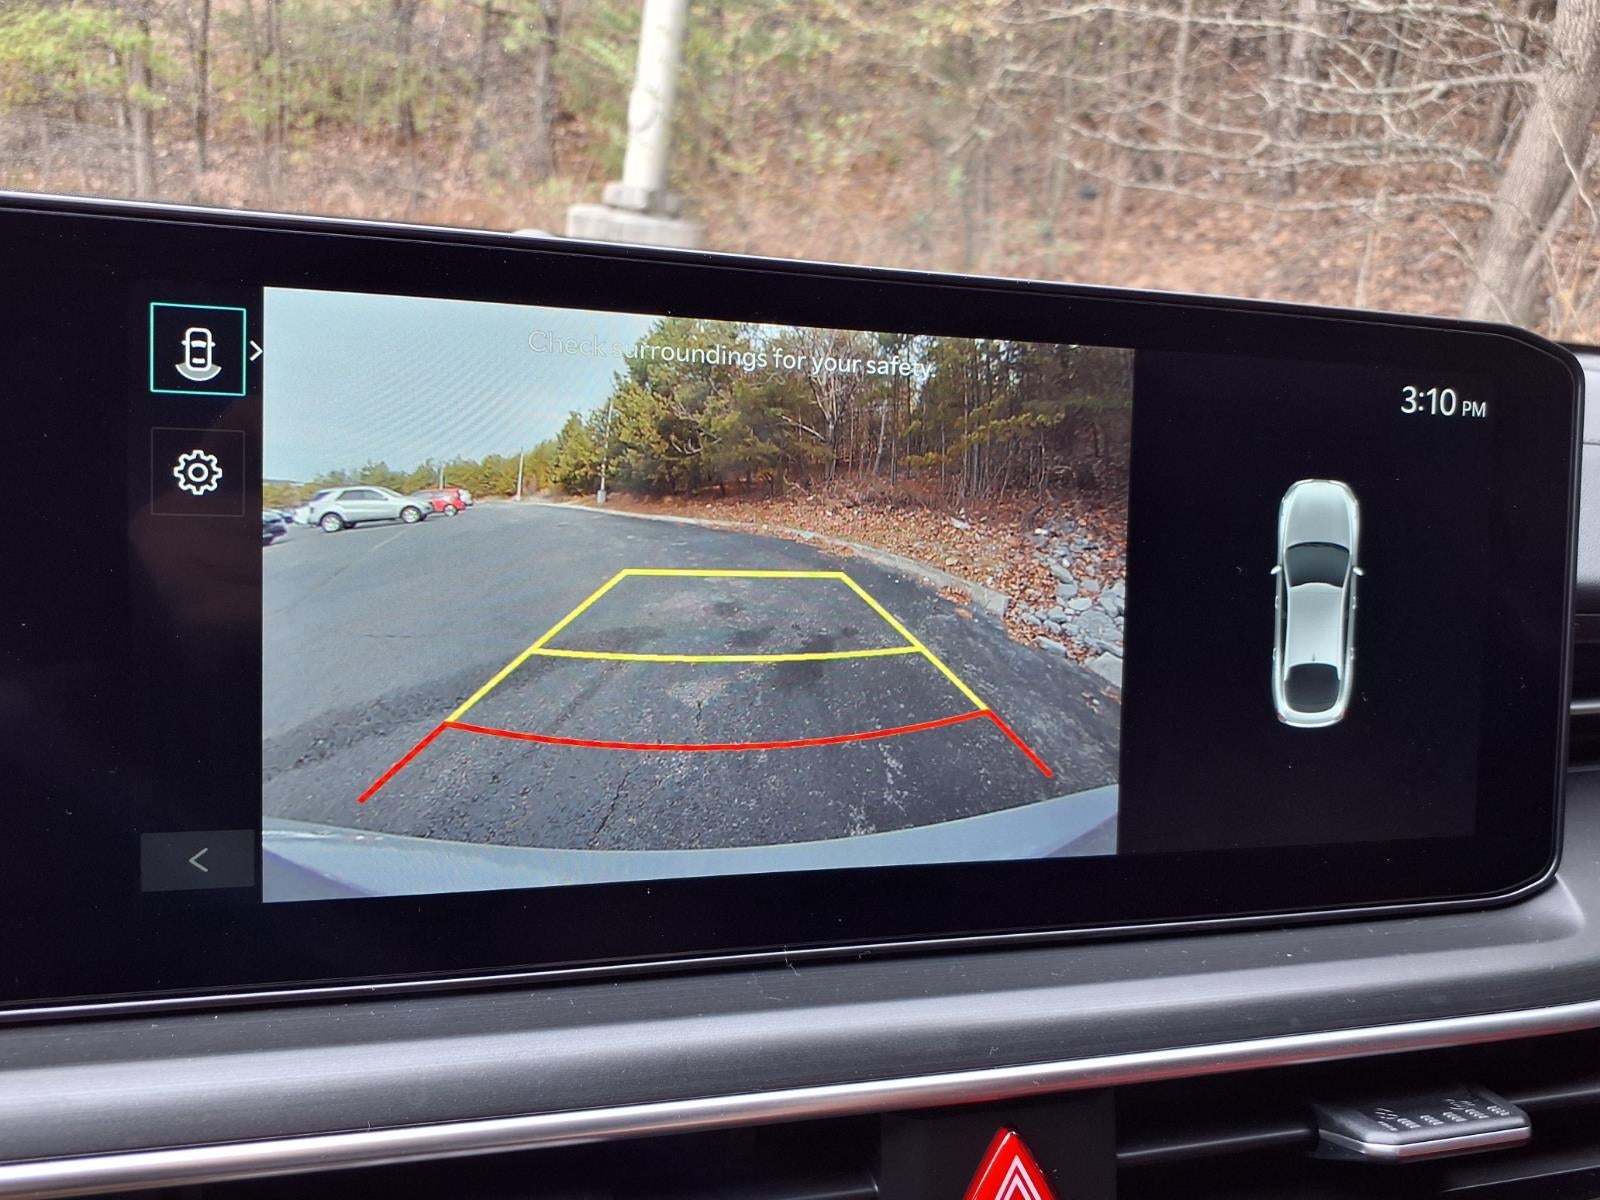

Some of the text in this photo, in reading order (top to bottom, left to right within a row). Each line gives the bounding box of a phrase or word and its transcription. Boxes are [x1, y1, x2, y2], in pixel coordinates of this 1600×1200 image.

[612, 337, 768, 373] surroundings
[773, 347, 807, 369] for
[811, 354, 863, 376] your
[1400, 385, 1487, 418] 3:10 PM
